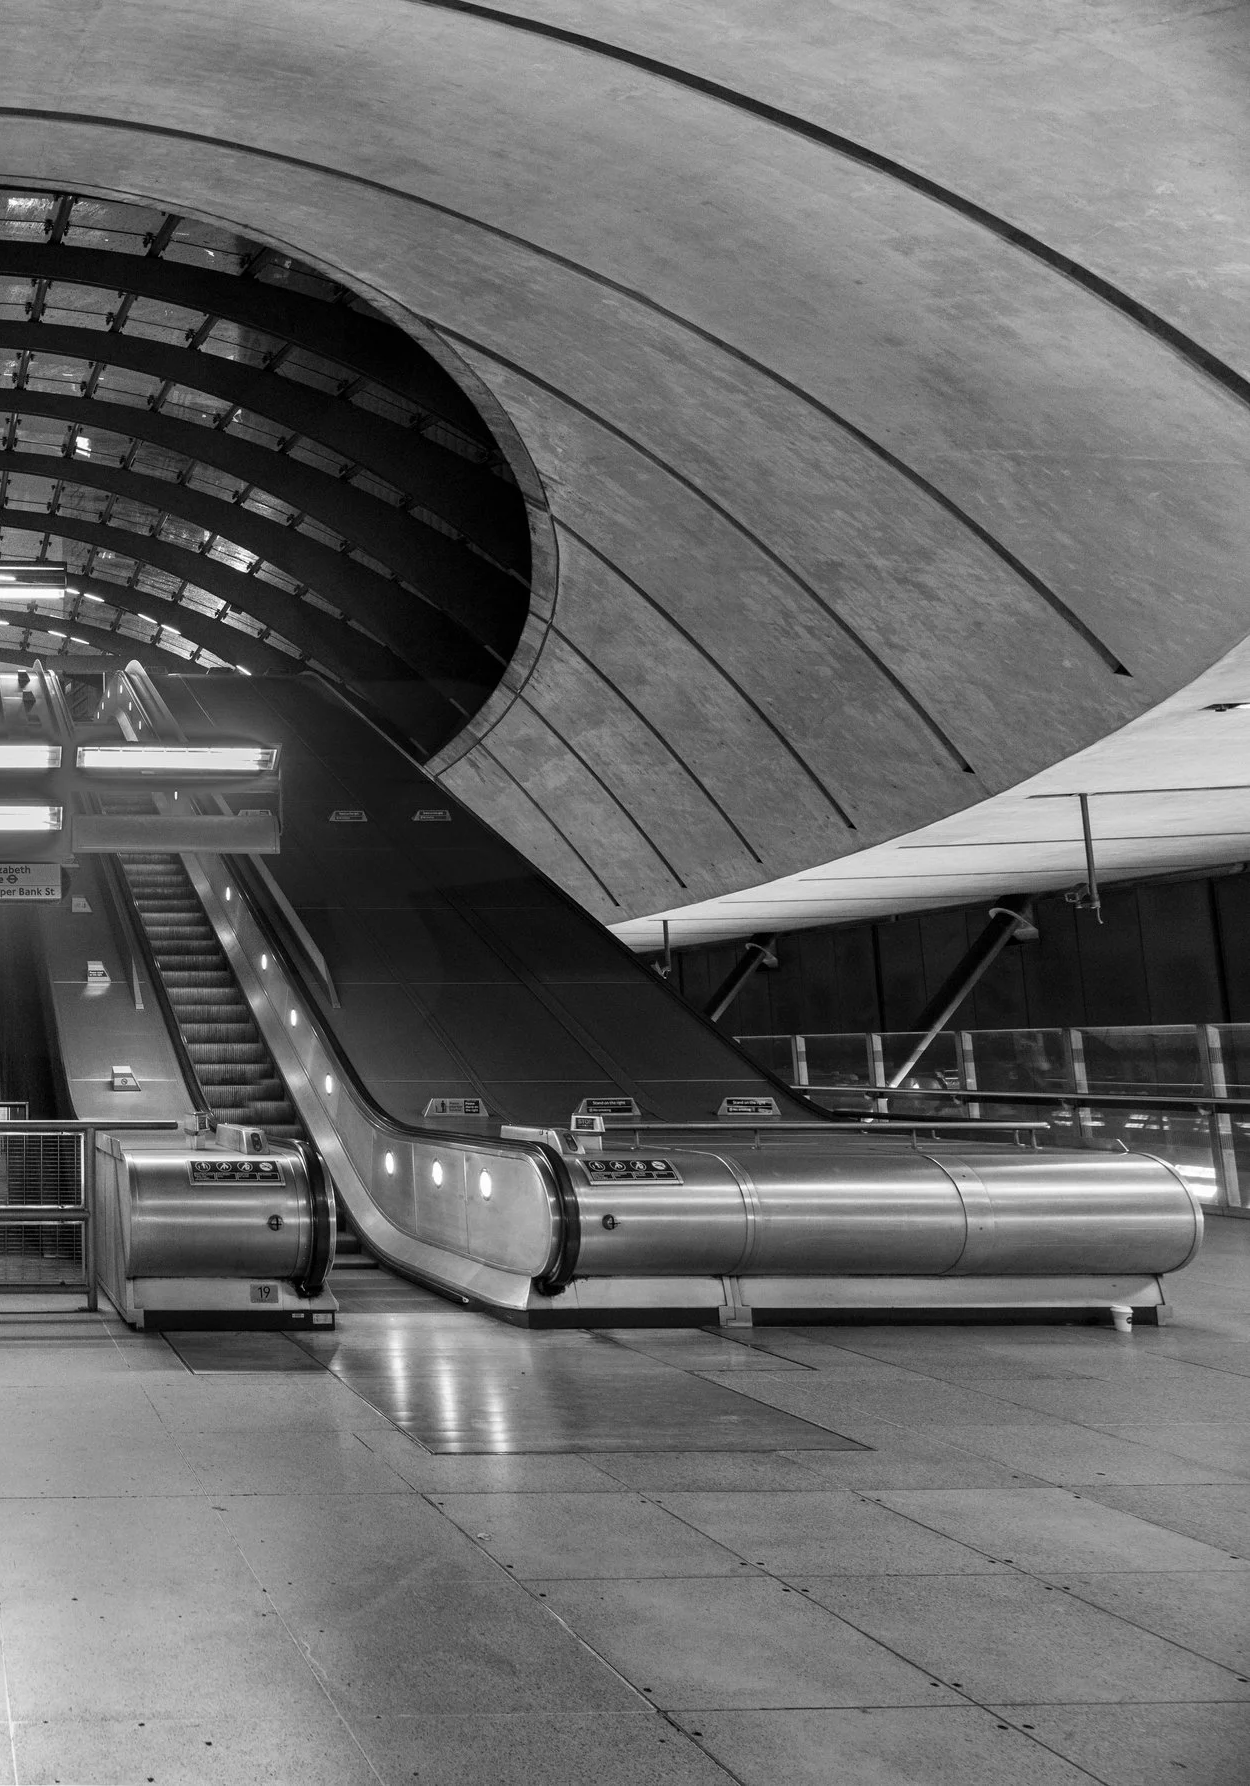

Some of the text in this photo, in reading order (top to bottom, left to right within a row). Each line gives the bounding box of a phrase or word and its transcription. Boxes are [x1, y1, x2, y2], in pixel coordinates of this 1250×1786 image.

[19, 887, 42, 896] Bank
[45, 887, 56, 896] St
[257, 1286, 271, 1299] 19
